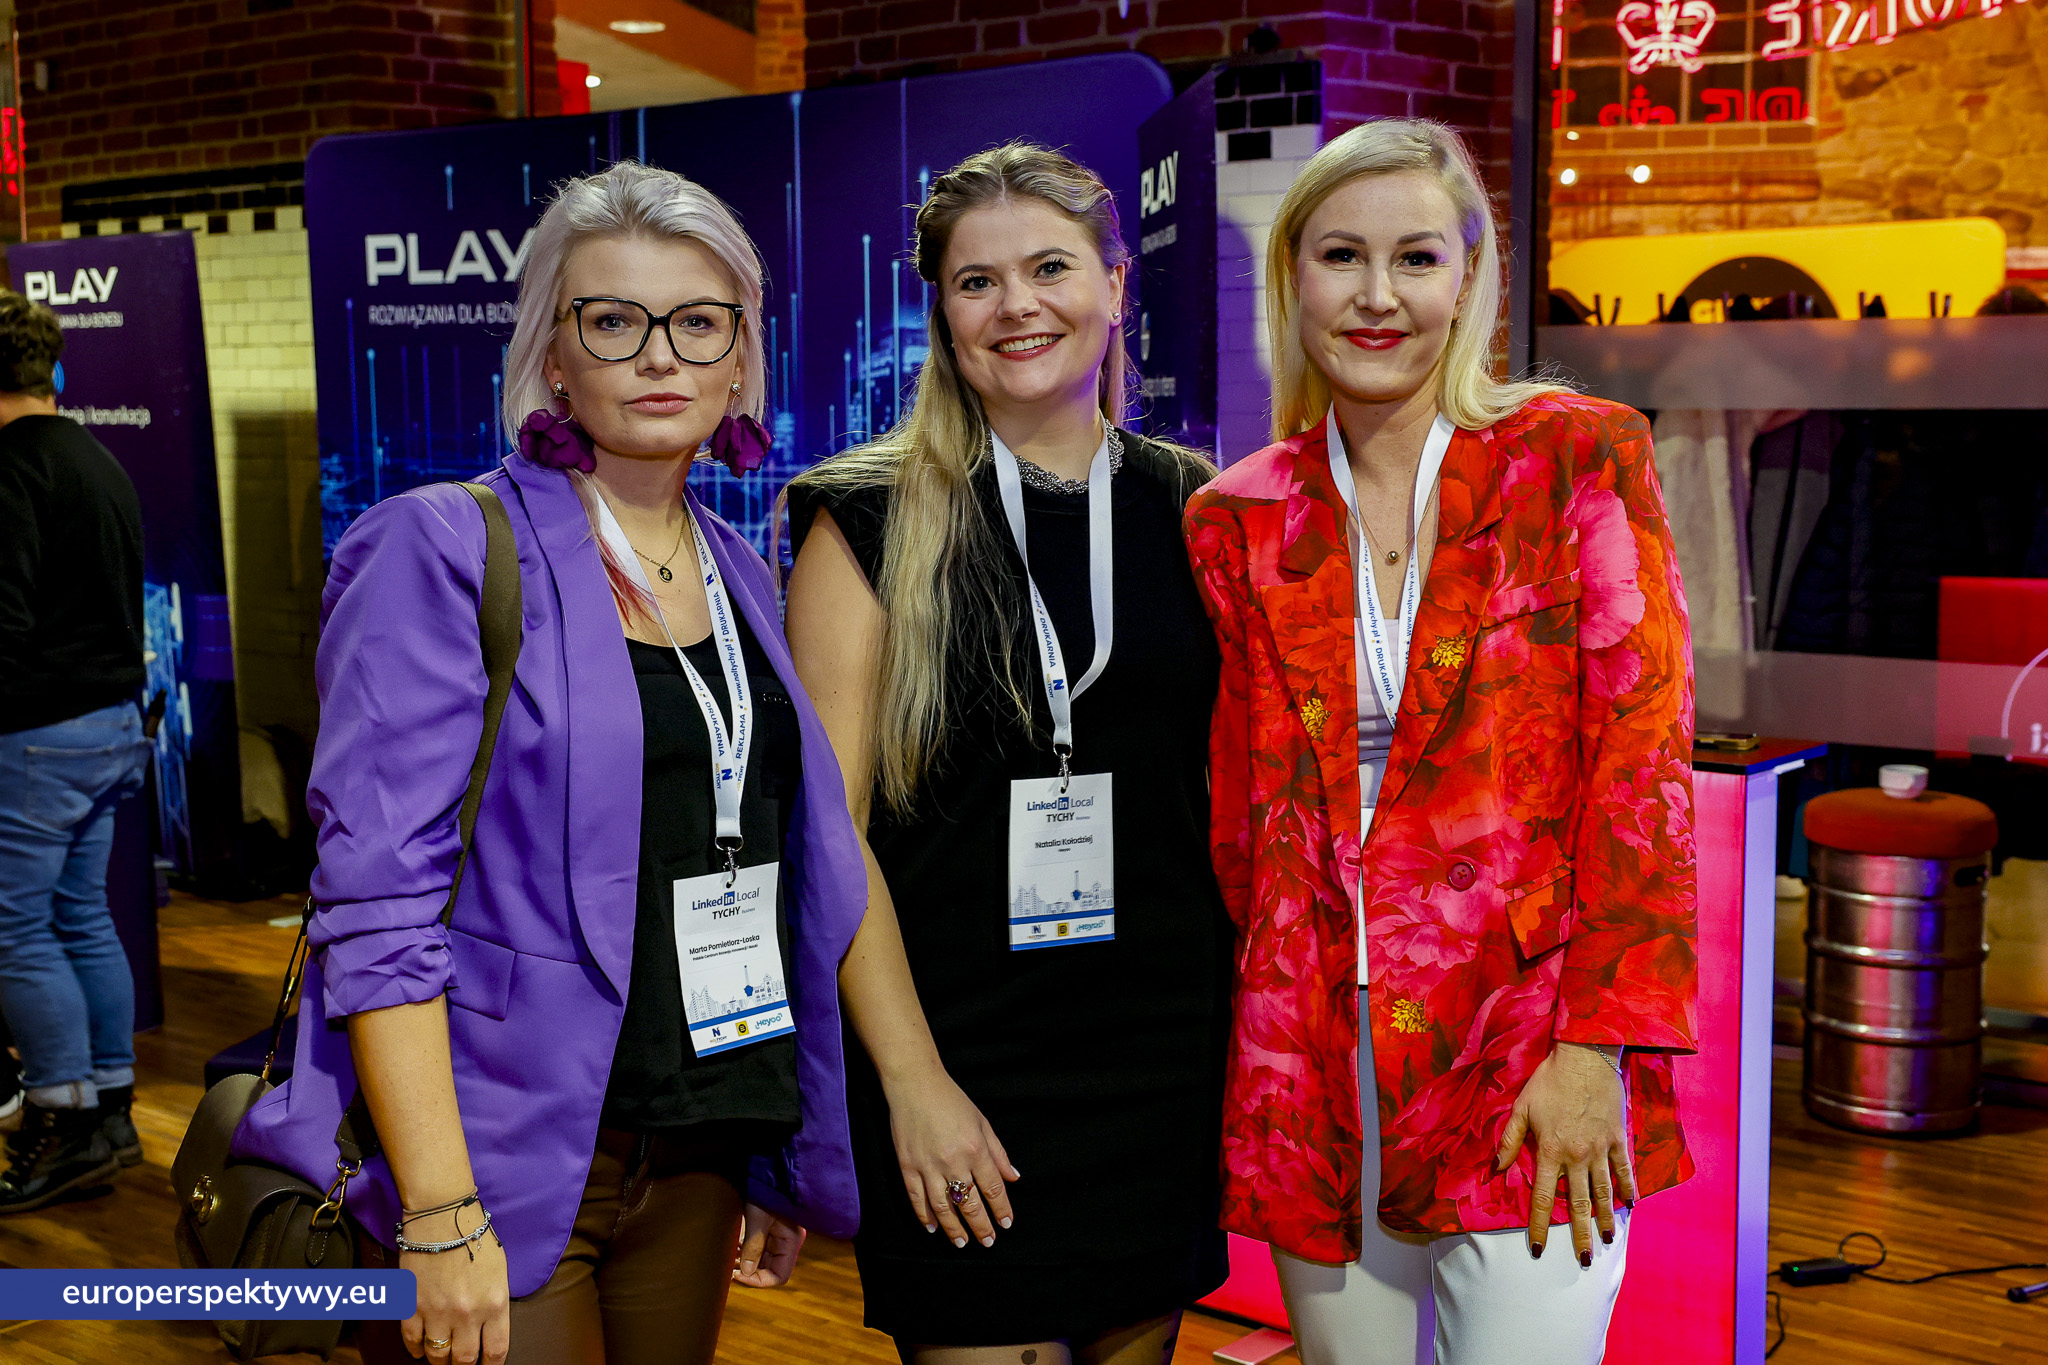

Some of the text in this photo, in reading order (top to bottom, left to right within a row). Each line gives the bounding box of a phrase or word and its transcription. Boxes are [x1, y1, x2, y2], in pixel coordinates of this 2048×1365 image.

[1140, 150, 1179, 220] PLAY
[364, 228, 536, 287] PLAY
[24, 266, 119, 306] PLAY
[457, 303, 485, 325] DLA
[713, 591, 730, 636] DRUKARNIA
[1406, 569, 1415, 637] www.noltychy.pl
[1040, 617, 1056, 668] DRUKARNIA
[1365, 576, 1381, 638] www.noltychy.pl
[1375, 647, 1395, 702] DRUKARNIA
[726, 644, 744, 702] www.noltychy.pl
[704, 701, 726, 758] DRUKARNIA
[735, 713, 746, 759] REKLAMA
[1046, 812, 1075, 822] TYCHY
[1070, 796, 1094, 808] Local
[1035, 839, 1061, 848] Natalia
[712, 906, 741, 920] TYCHY
[736, 887, 760, 902] Local
[689, 946, 708, 955] Marta
